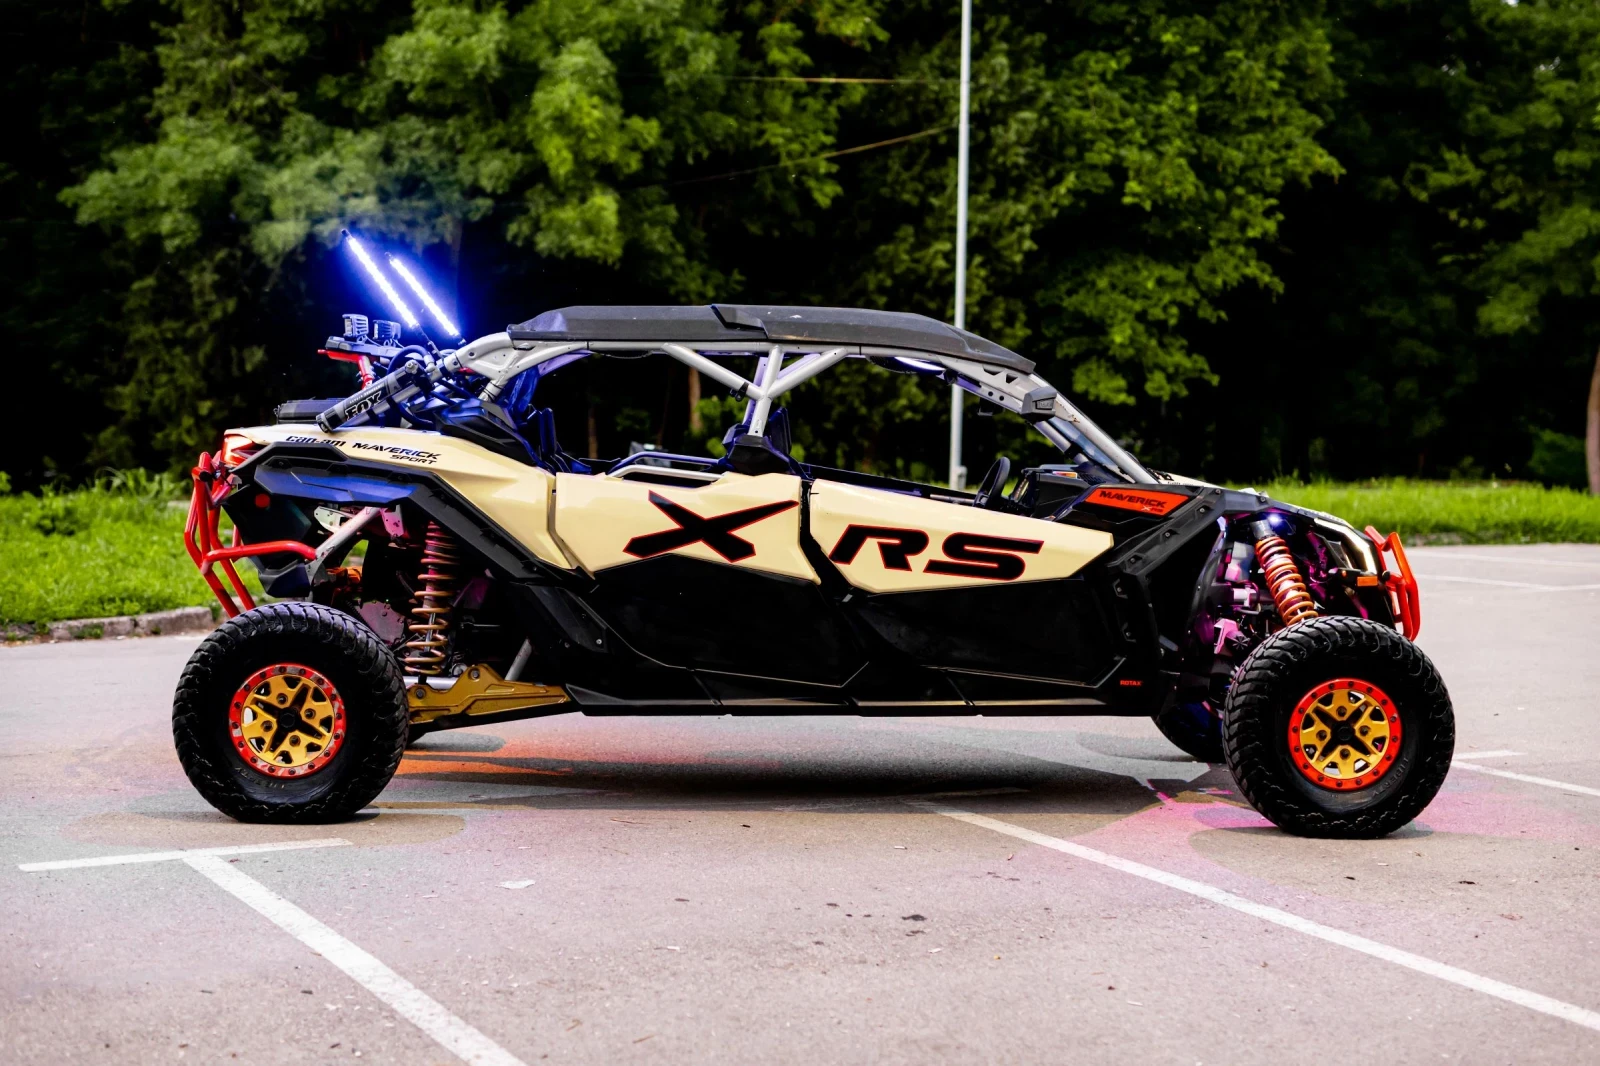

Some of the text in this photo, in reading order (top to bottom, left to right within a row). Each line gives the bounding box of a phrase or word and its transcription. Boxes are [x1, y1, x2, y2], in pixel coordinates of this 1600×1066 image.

[344, 390, 382, 422] FOX
[352, 442, 442, 460] MAVERICK
[389, 454, 438, 465] SPORT
[1099, 490, 1167, 508] MAVERICK
[622, 489, 1045, 581] X RS
